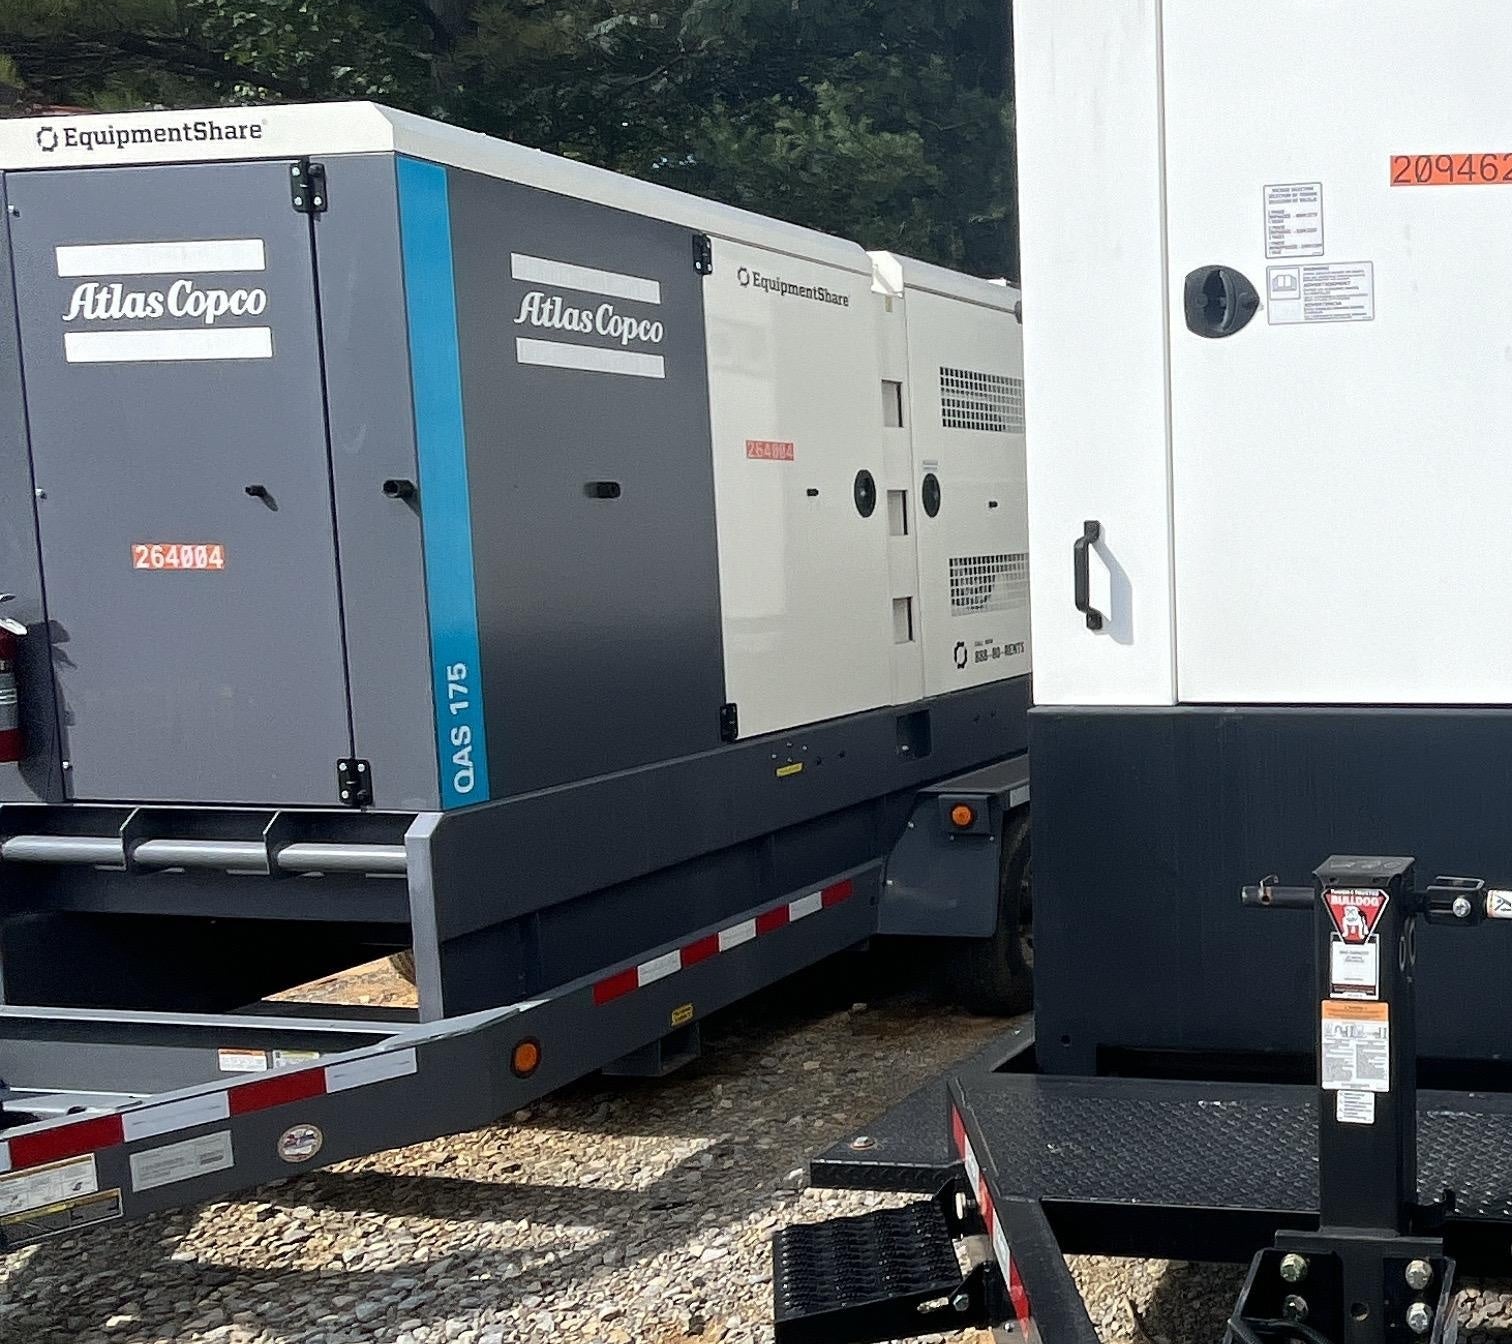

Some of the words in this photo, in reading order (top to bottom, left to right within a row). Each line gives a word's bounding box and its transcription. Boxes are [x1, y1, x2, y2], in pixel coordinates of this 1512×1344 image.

[63, 121, 263, 150] EquipmentShare
[62, 282, 165, 321] Atlas
[167, 279, 267, 324] Copco
[752, 271, 850, 307] EquipmentShare
[513, 291, 594, 333] Atlas
[595, 303, 664, 345] Copco
[135, 545, 224, 568] 264004
[446, 662, 469, 715] 175
[450, 725, 475, 794] QAS
